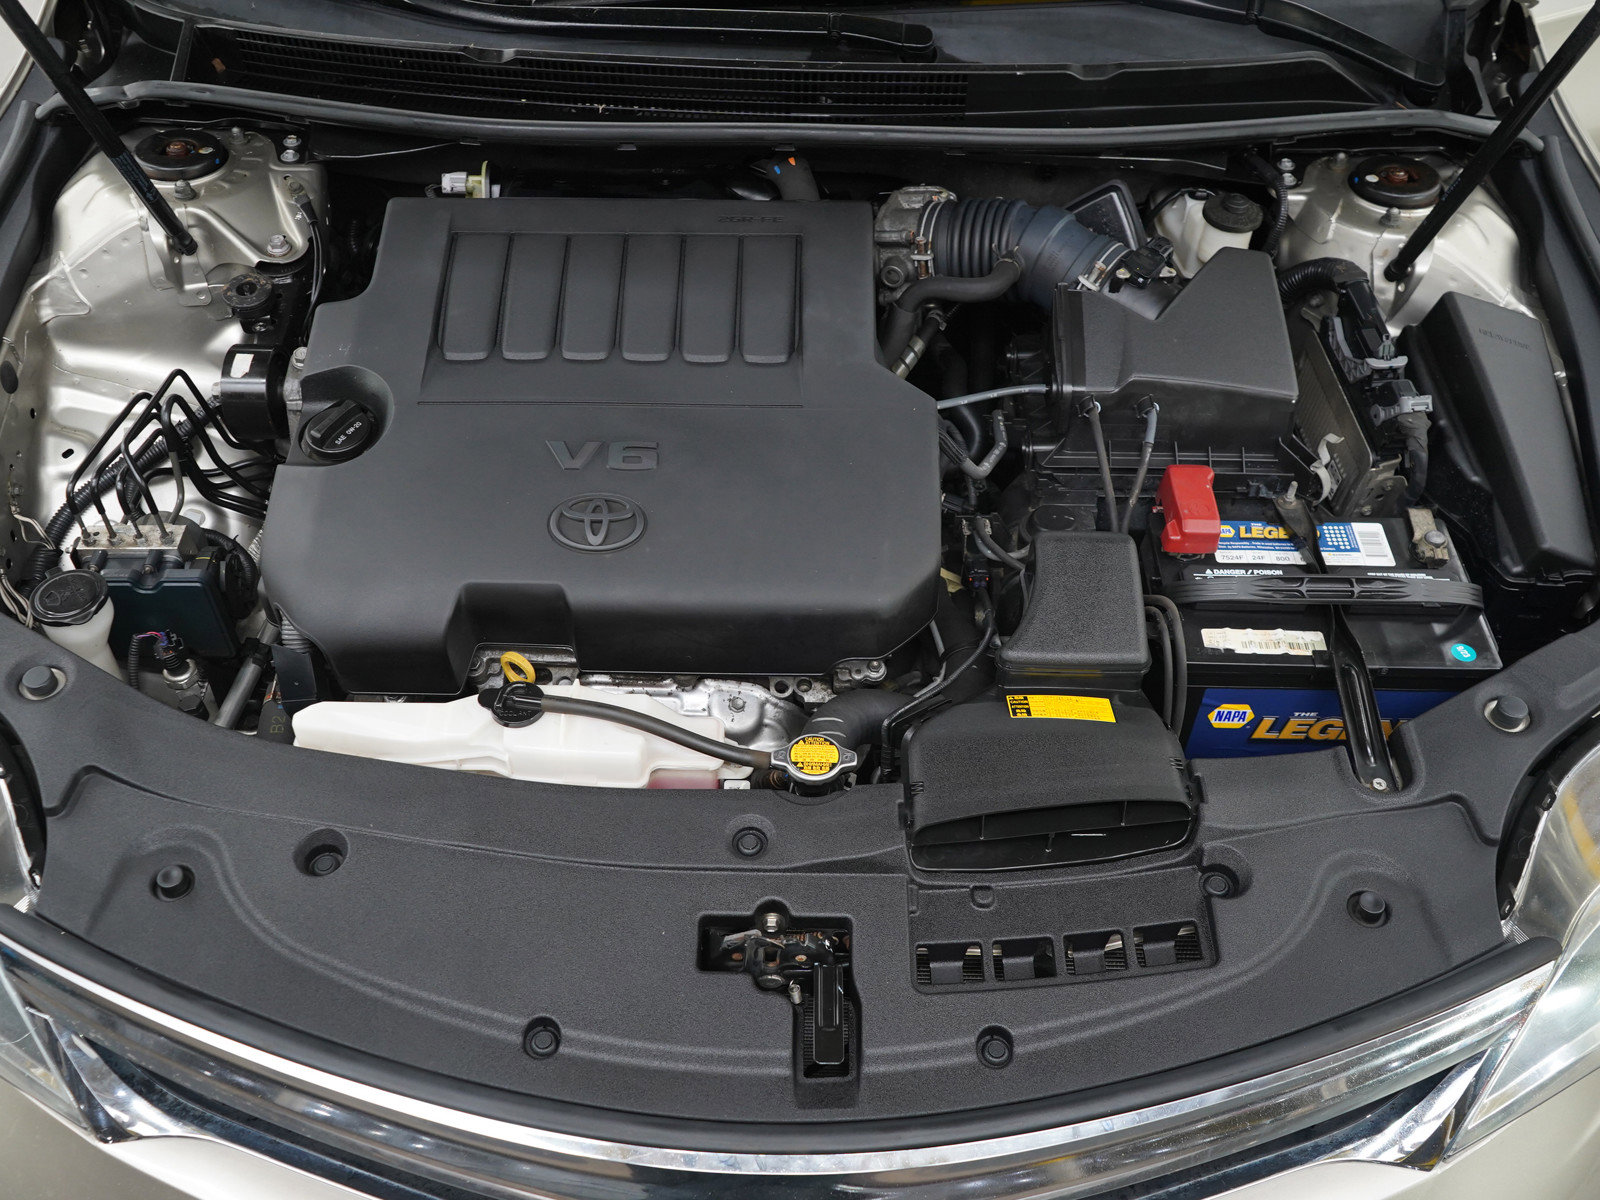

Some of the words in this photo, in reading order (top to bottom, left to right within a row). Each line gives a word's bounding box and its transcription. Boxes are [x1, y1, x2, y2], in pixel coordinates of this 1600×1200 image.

[334, 434, 347, 445] SAE
[345, 420, 362, 435] 0W-20
[545, 440, 659, 471] V6
[1213, 568, 1246, 576] DANGER
[1214, 710, 1247, 722] NAPA
